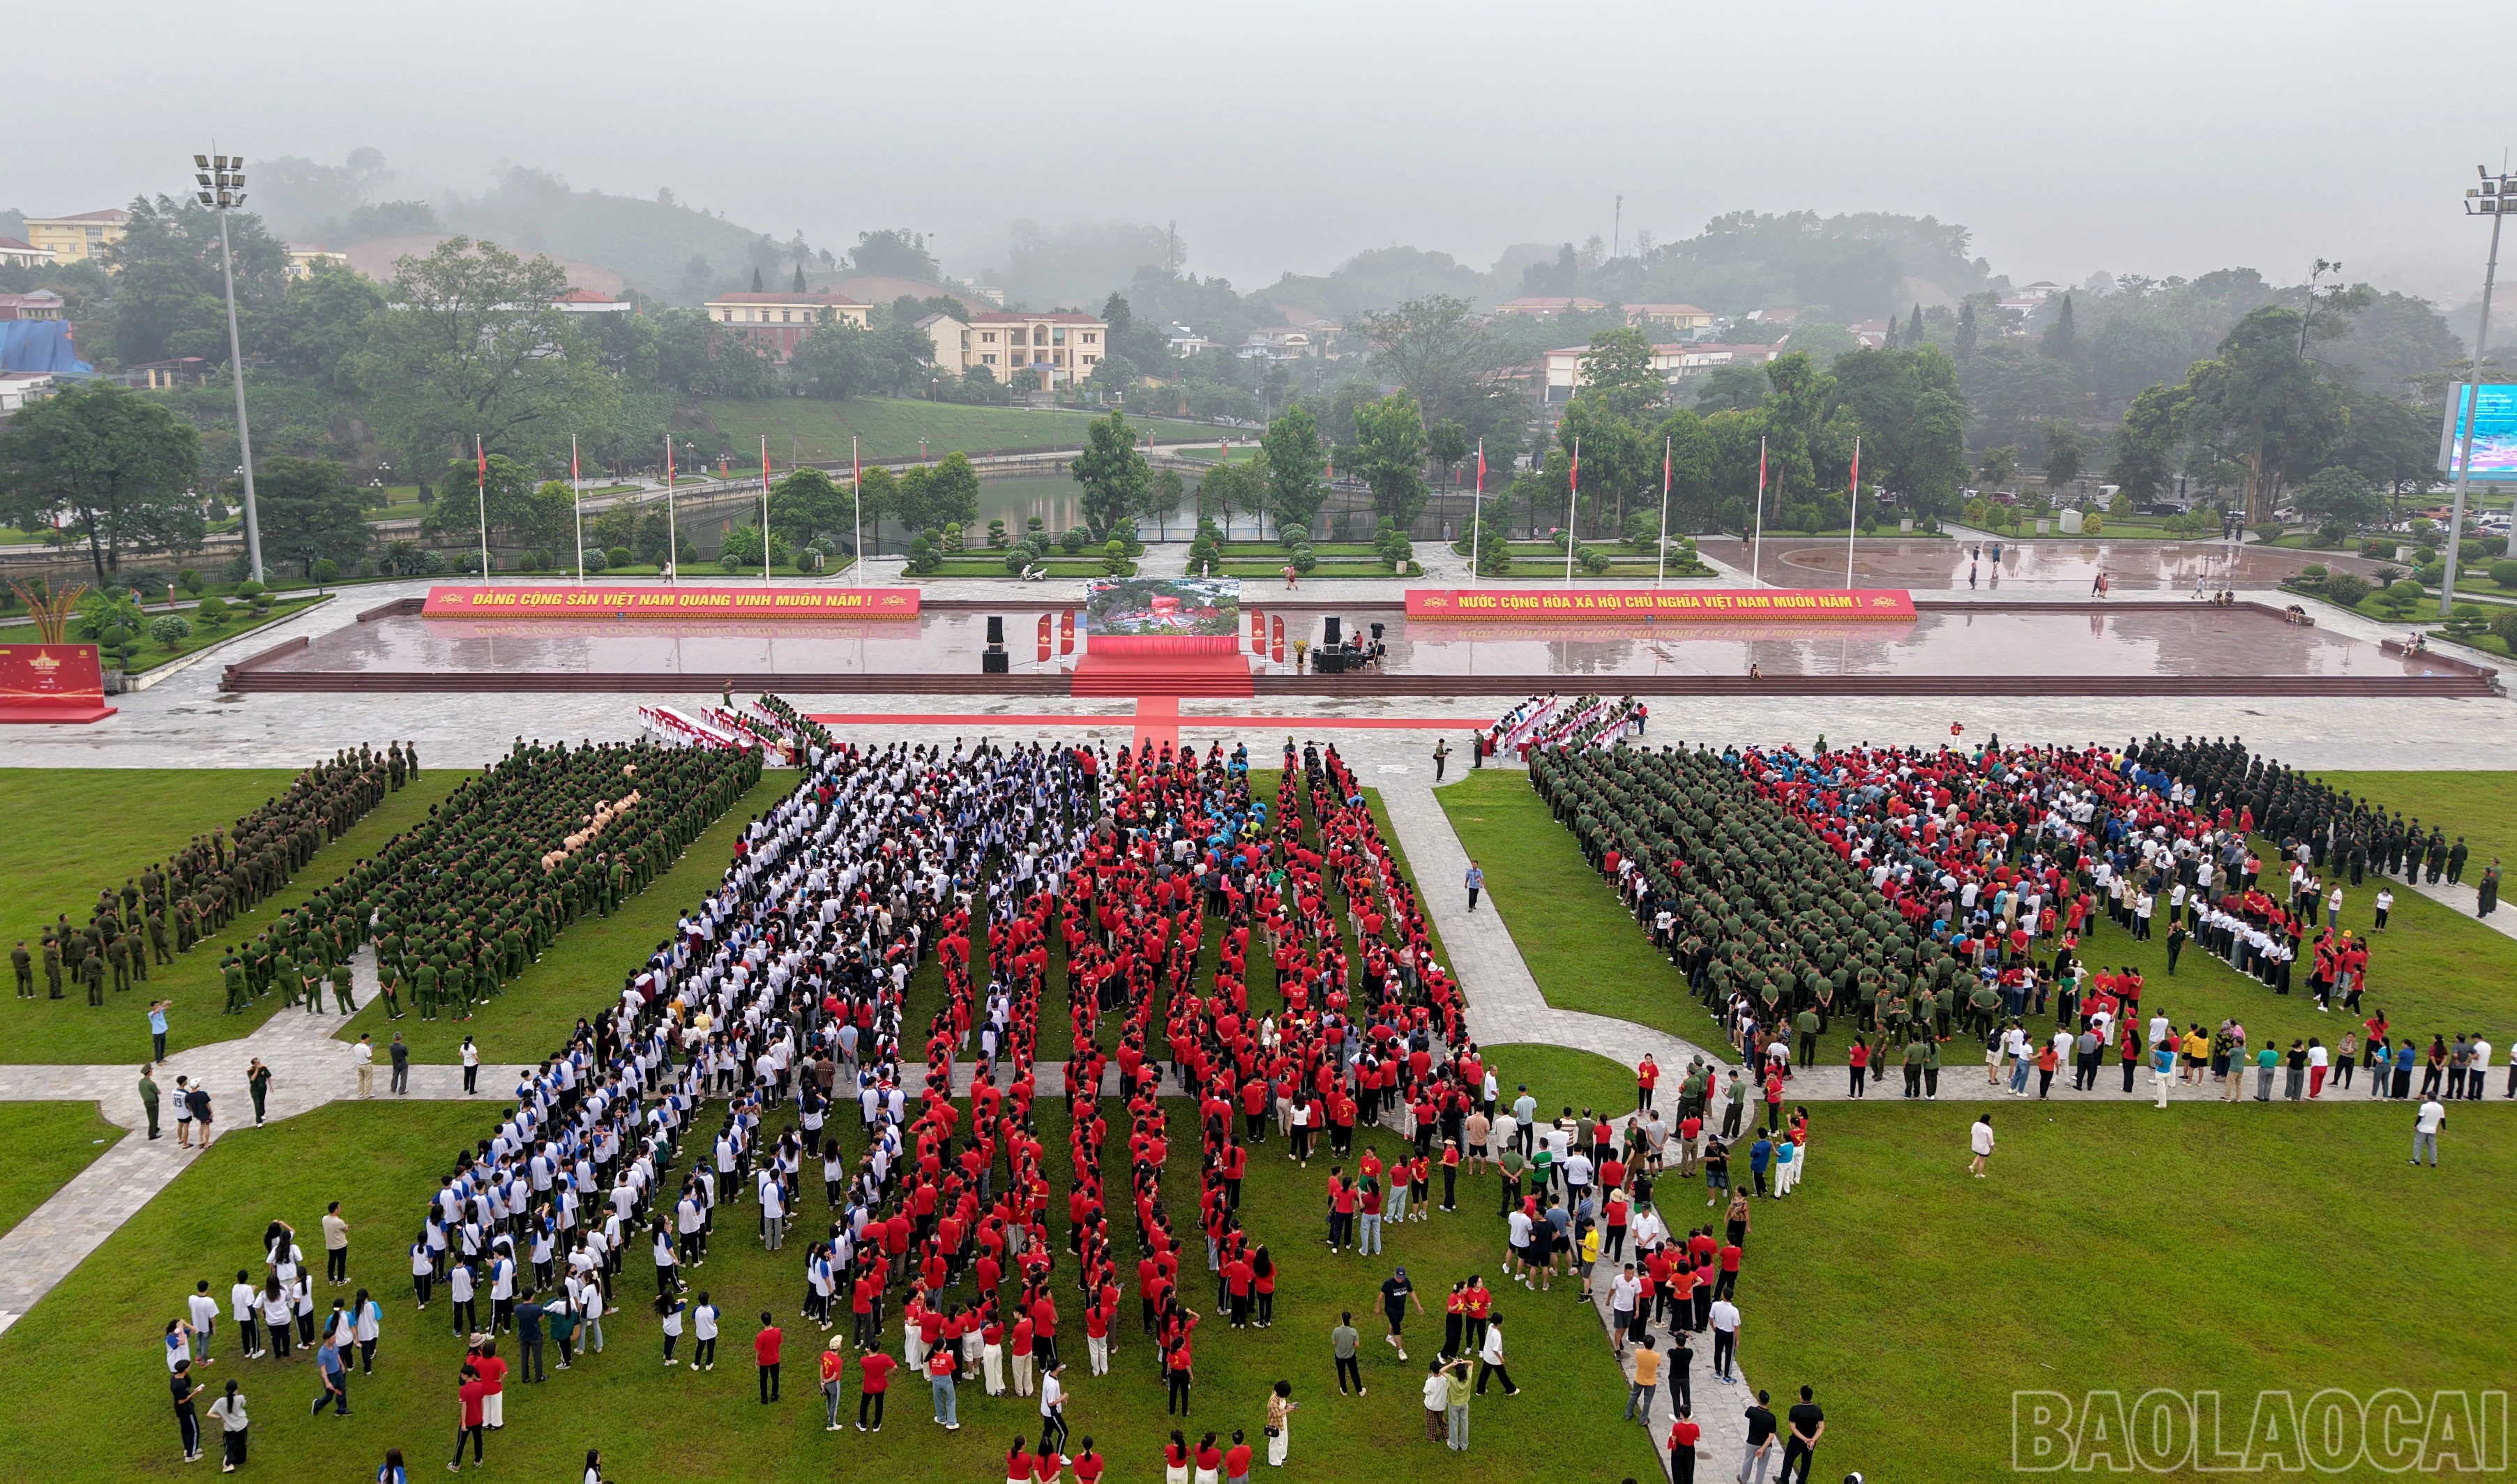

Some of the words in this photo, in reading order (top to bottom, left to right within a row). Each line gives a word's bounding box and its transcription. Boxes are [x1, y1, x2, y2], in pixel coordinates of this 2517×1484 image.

[472, 589, 517, 605] ĐẢNG
[520, 591, 564, 607] CỘNG
[566, 590, 600, 605] SẢN
[603, 591, 636, 608] VIỆT
[638, 594, 676, 606] NAM
[679, 594, 732, 607] QUANG
[735, 595, 772, 606] VINH
[775, 592, 822, 606] MUÔN
[825, 593, 862, 607] NĂM
[866, 595, 872, 607] !
[1458, 594, 1497, 608] NƯỚC
[1500, 594, 1540, 610] CỘNG
[1542, 594, 1572, 608] HÒA
[1574, 594, 1595, 608] XÃ
[1596, 593, 1622, 610] HỘI
[1624, 593, 1654, 608] CHỦ
[1656, 593, 1702, 608] NGHĨA
[1702, 593, 1732, 610] VIỆT
[1735, 596, 1771, 607] NAM
[1772, 593, 1817, 608] MUÔN
[1818, 593, 1853, 608] NĂM
[1856, 596, 1862, 607] !
